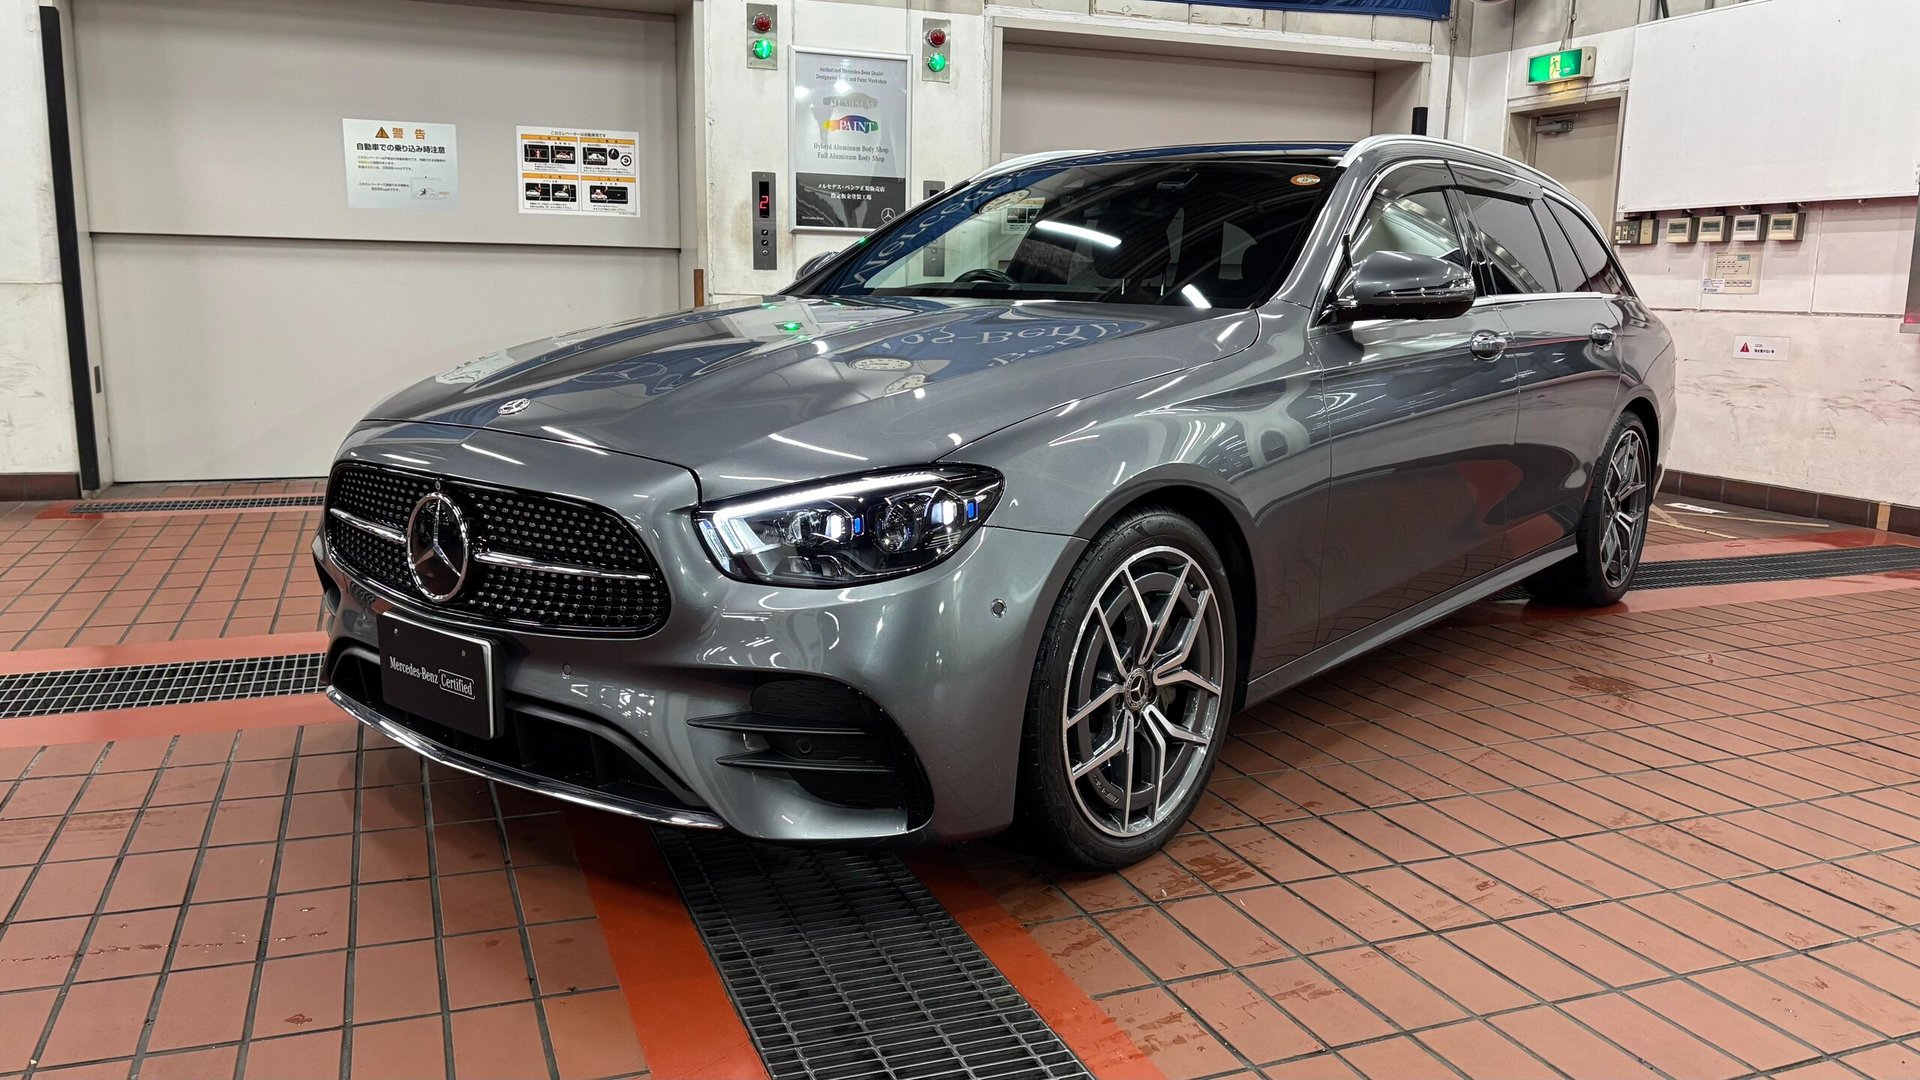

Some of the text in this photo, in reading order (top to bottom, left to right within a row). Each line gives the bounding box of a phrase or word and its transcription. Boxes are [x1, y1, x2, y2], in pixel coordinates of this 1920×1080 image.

[815, 73, 838, 81] Designated
[868, 77, 887, 85] Workshop
[839, 120, 875, 132] PAINT
[356, 142, 446, 154] 自動車での乗り込み時注意
[813, 142, 889, 155] Hybrid Aluminum Body Shop
[817, 151, 886, 164] Full Aluminum Body Shop
[818, 183, 886, 193] メルセデス・ベンツ正規販売店
[759, 195, 769, 209] 2
[389, 655, 473, 696] Mercedes-Benz Certified
